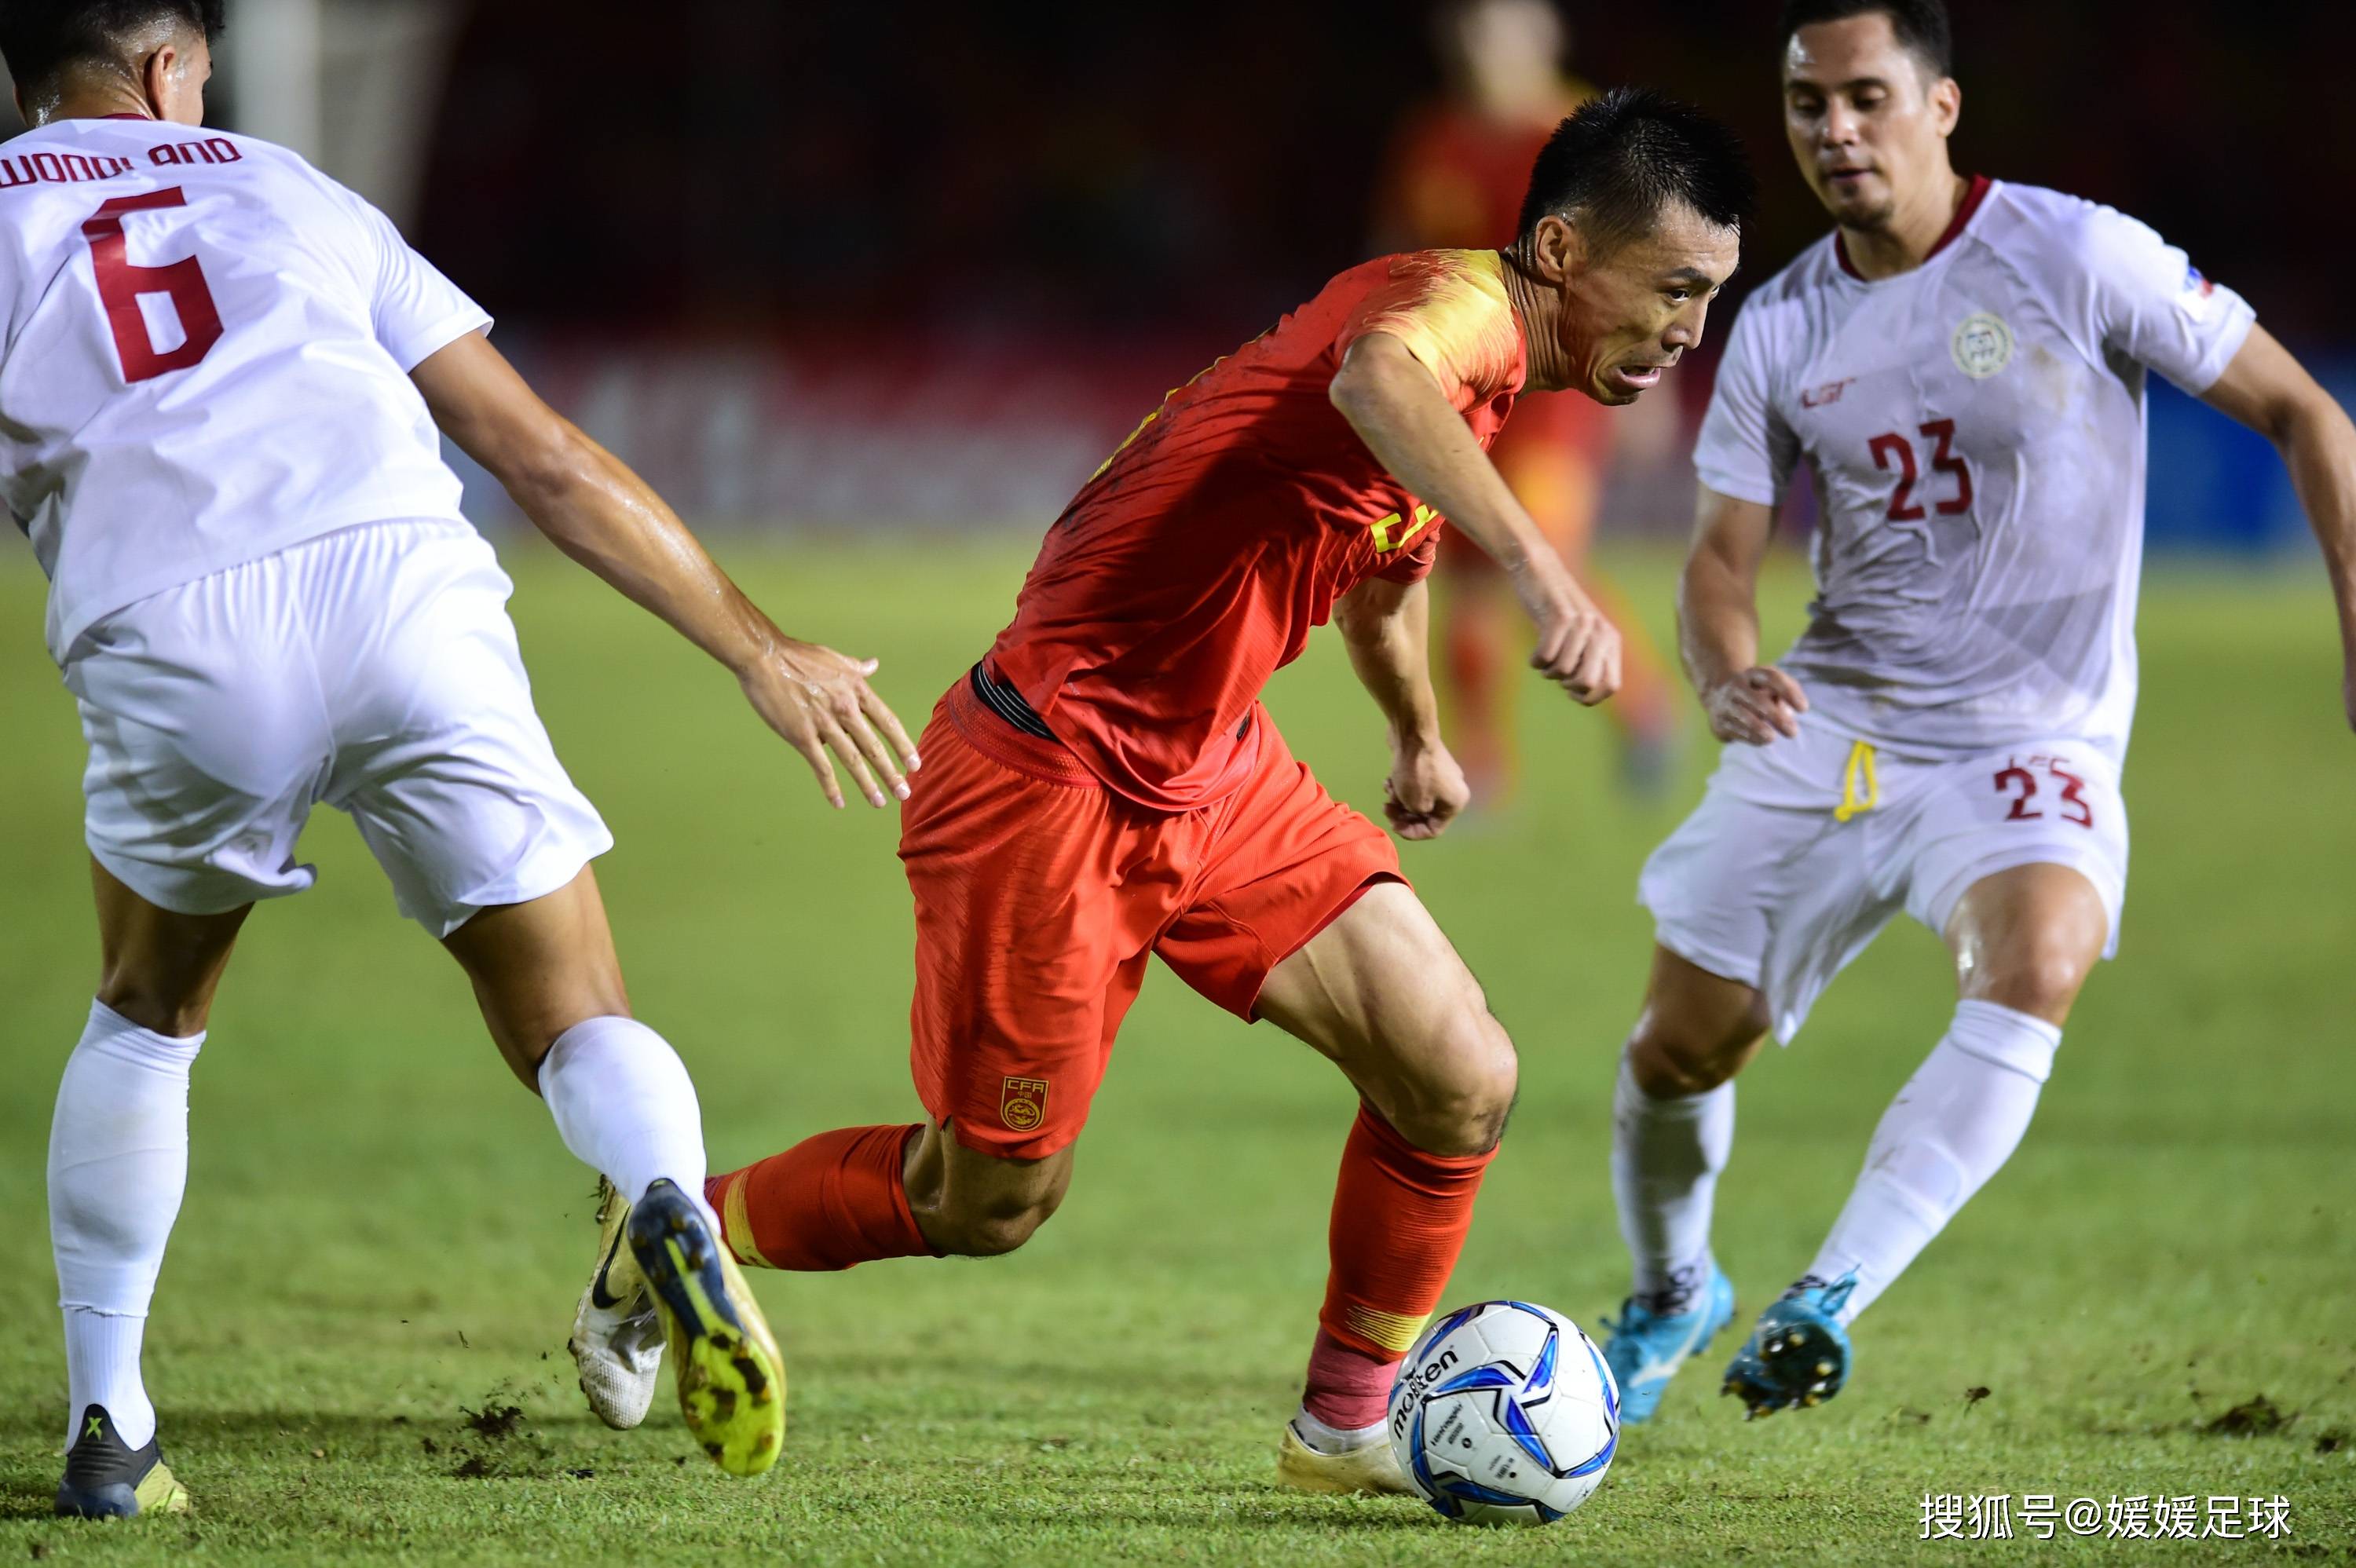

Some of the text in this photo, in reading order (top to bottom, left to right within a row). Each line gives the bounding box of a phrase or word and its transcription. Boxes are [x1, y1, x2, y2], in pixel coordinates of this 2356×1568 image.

[81, 185, 225, 384] 6
[1868, 418, 1974, 522] 23
[1994, 767, 2092, 829] 23
[1007, 1080, 1044, 1094] CFA
[1394, 1350, 1459, 1441] molten
